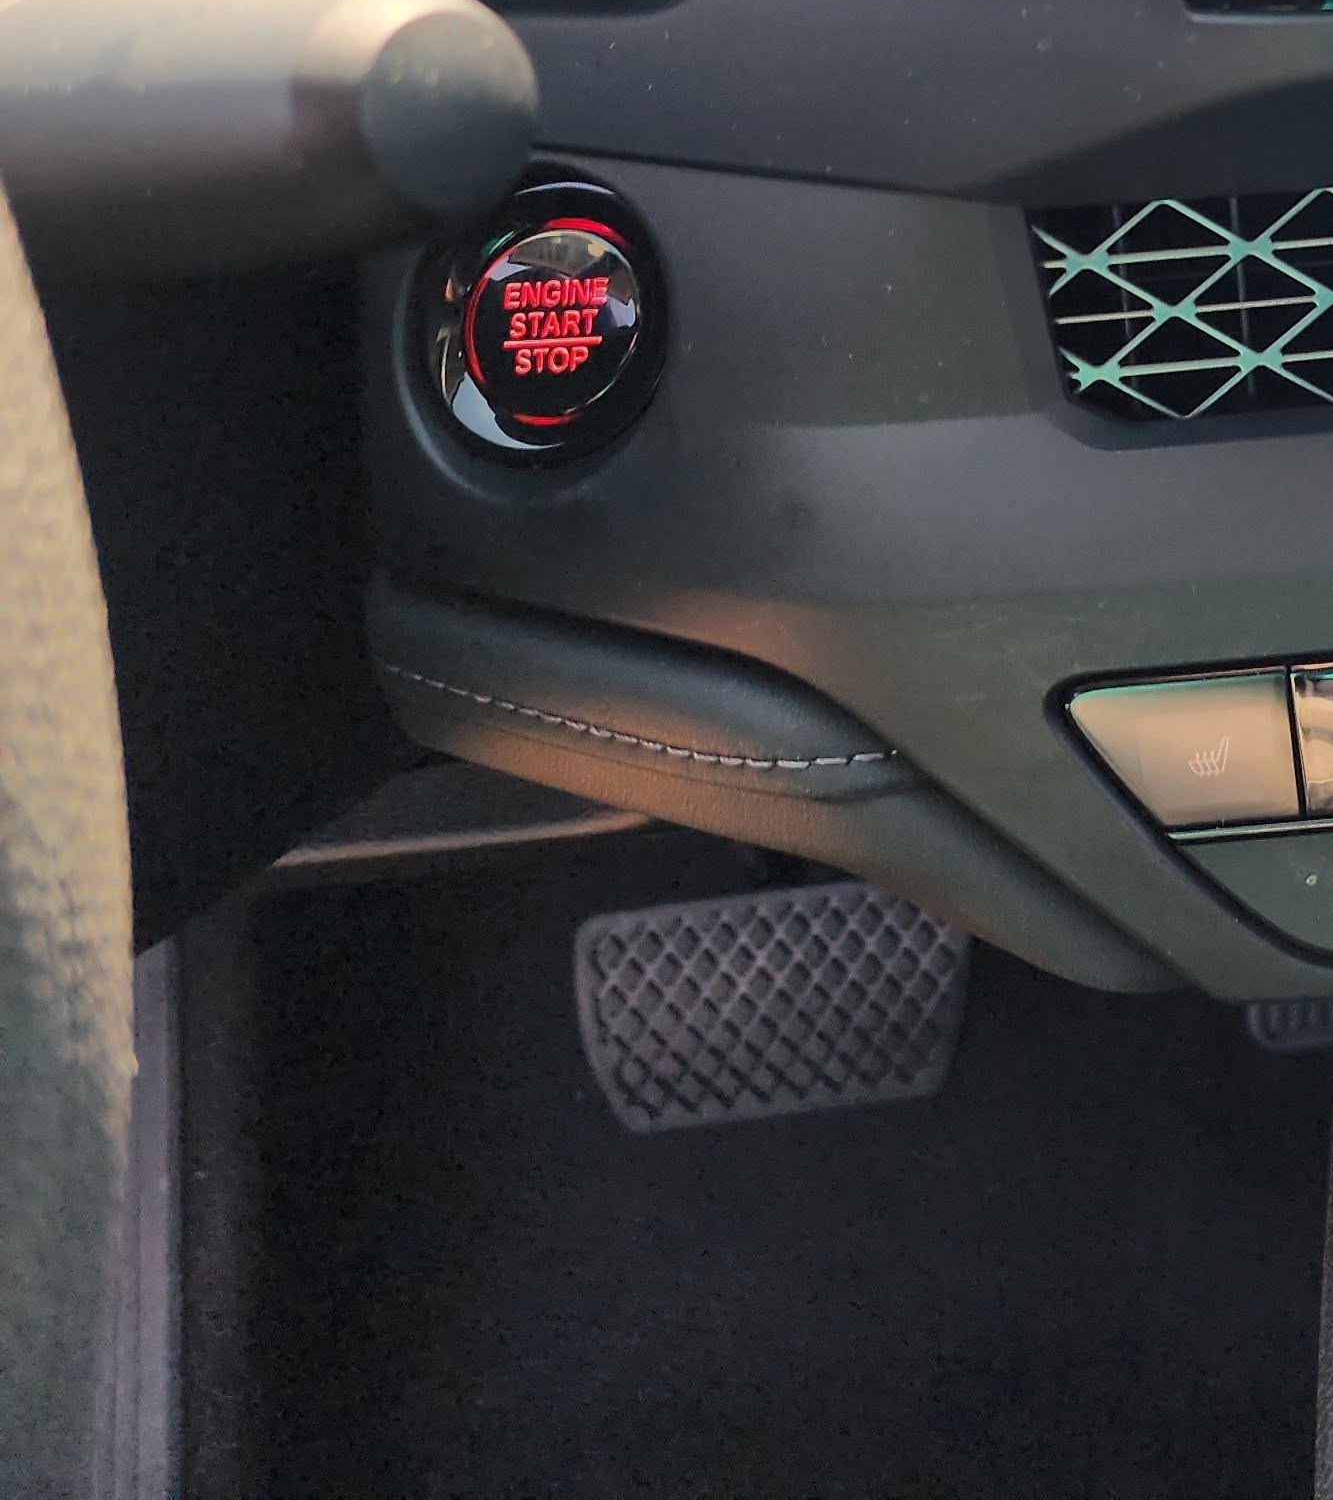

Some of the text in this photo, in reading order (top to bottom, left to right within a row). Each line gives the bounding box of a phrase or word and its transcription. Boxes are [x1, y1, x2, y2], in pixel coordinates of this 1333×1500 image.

[503, 276, 610, 311] ENGINE
[509, 308, 600, 341] START
[514, 346, 590, 376] STOP
